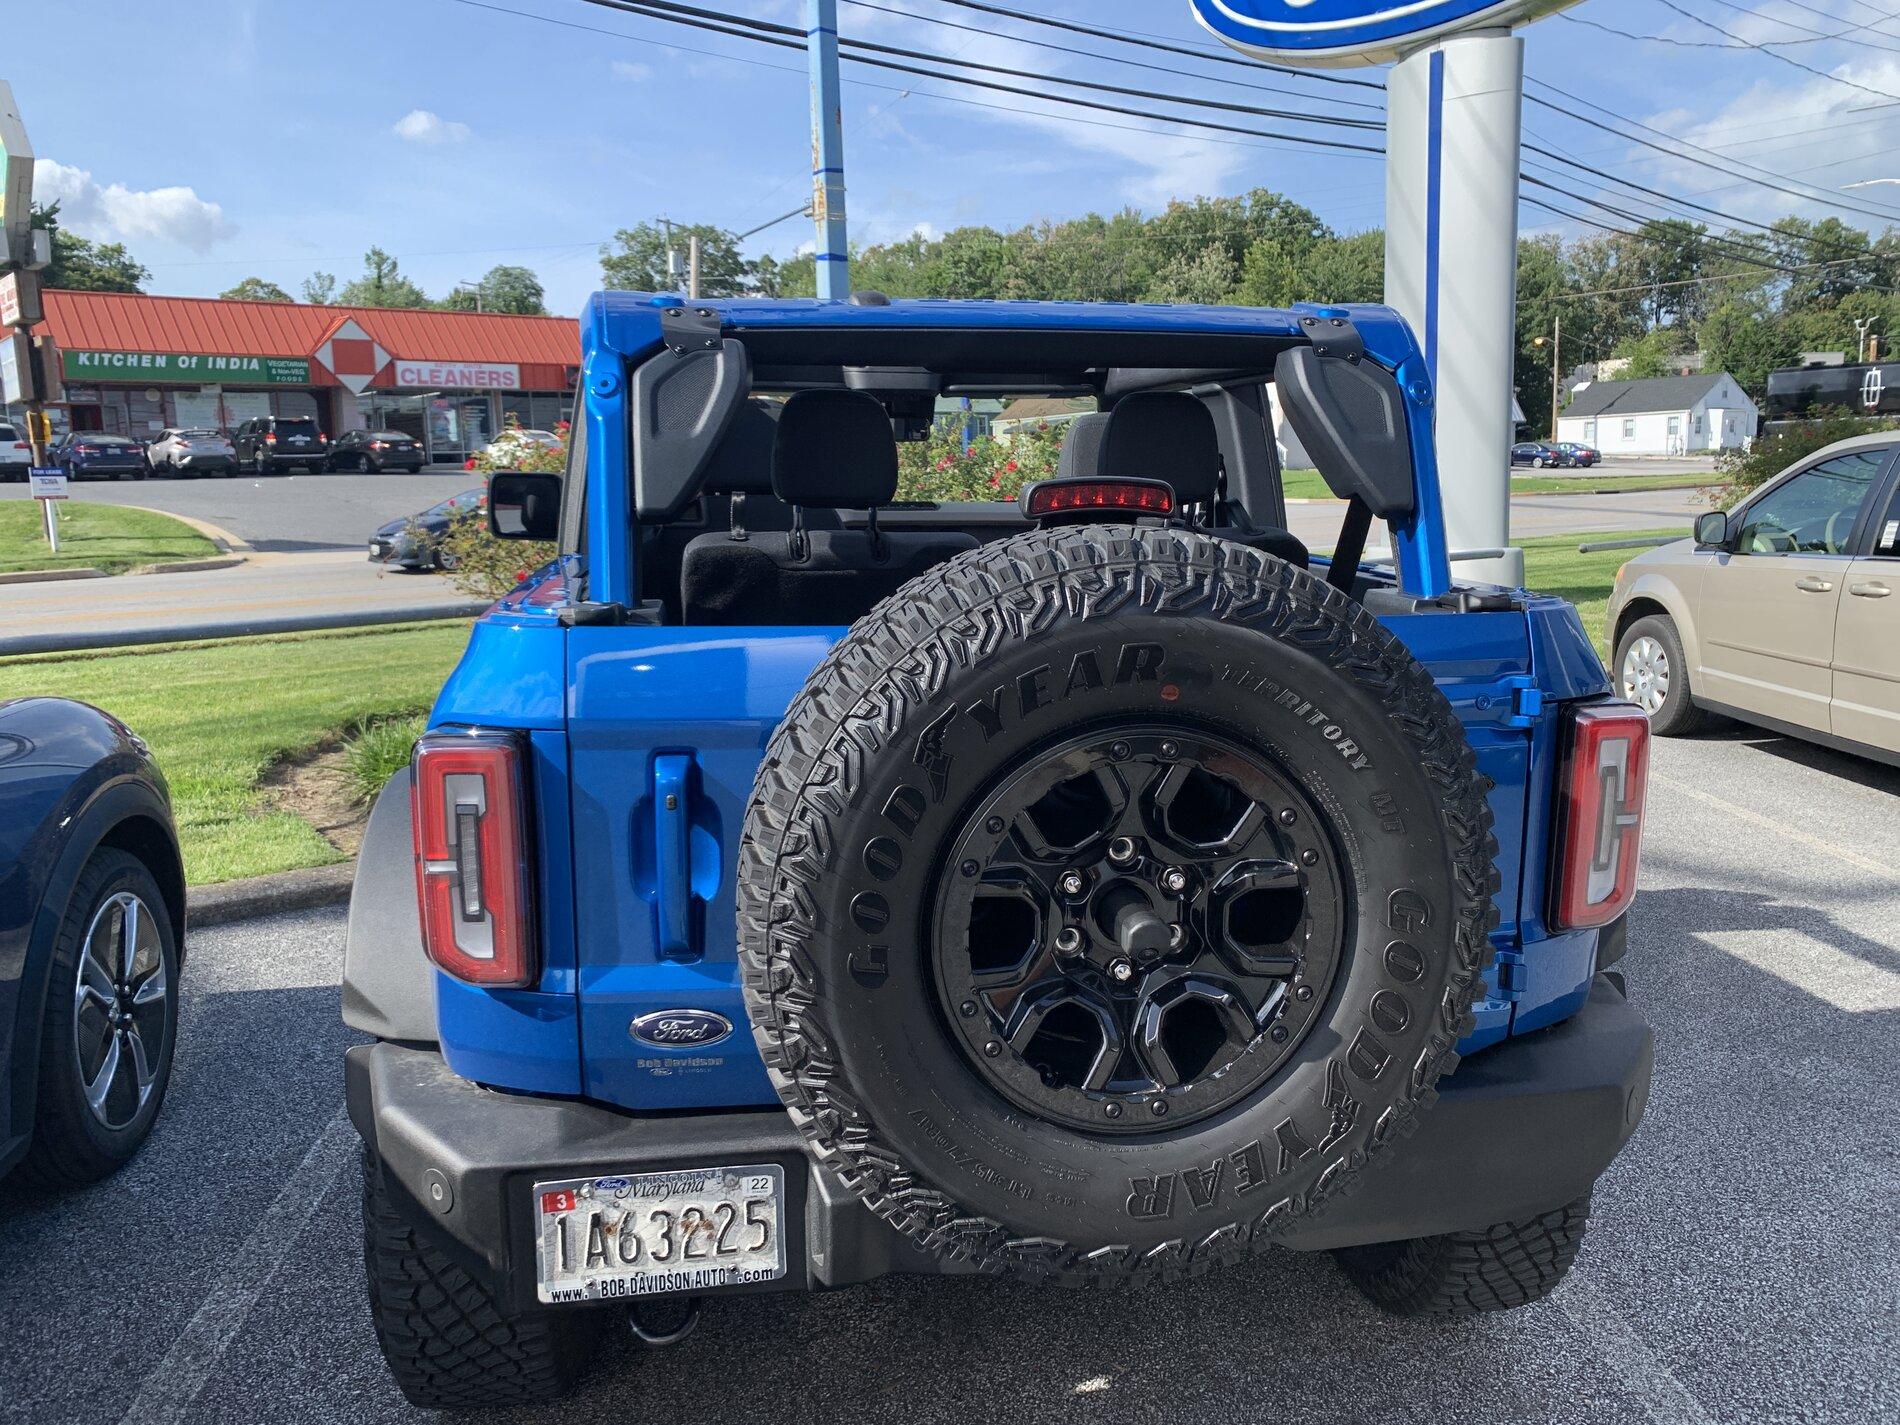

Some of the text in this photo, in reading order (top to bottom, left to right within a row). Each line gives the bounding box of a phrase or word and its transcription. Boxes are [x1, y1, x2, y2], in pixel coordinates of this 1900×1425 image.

[78, 353, 260, 370] KITCHEN Of INDIA
[267, 360, 308, 368] VEGETARIAN
[400, 368, 515, 386] CLEANERS
[653, 1018, 709, 1041] Ford
[637, 1057, 724, 1068] Bob Davidson
[600, 1170, 713, 1189] Ford LINCOLN
[751, 1178, 768, 1190] 22
[614, 1179, 706, 1202] Maryland
[556, 1194, 567, 1209] 3
[555, 1200, 770, 1272] 1A63225
[601, 1277, 625, 1298] BOB
[630, 1271, 691, 1294] DAVIDSON
[694, 1268, 726, 1287] AUTO
